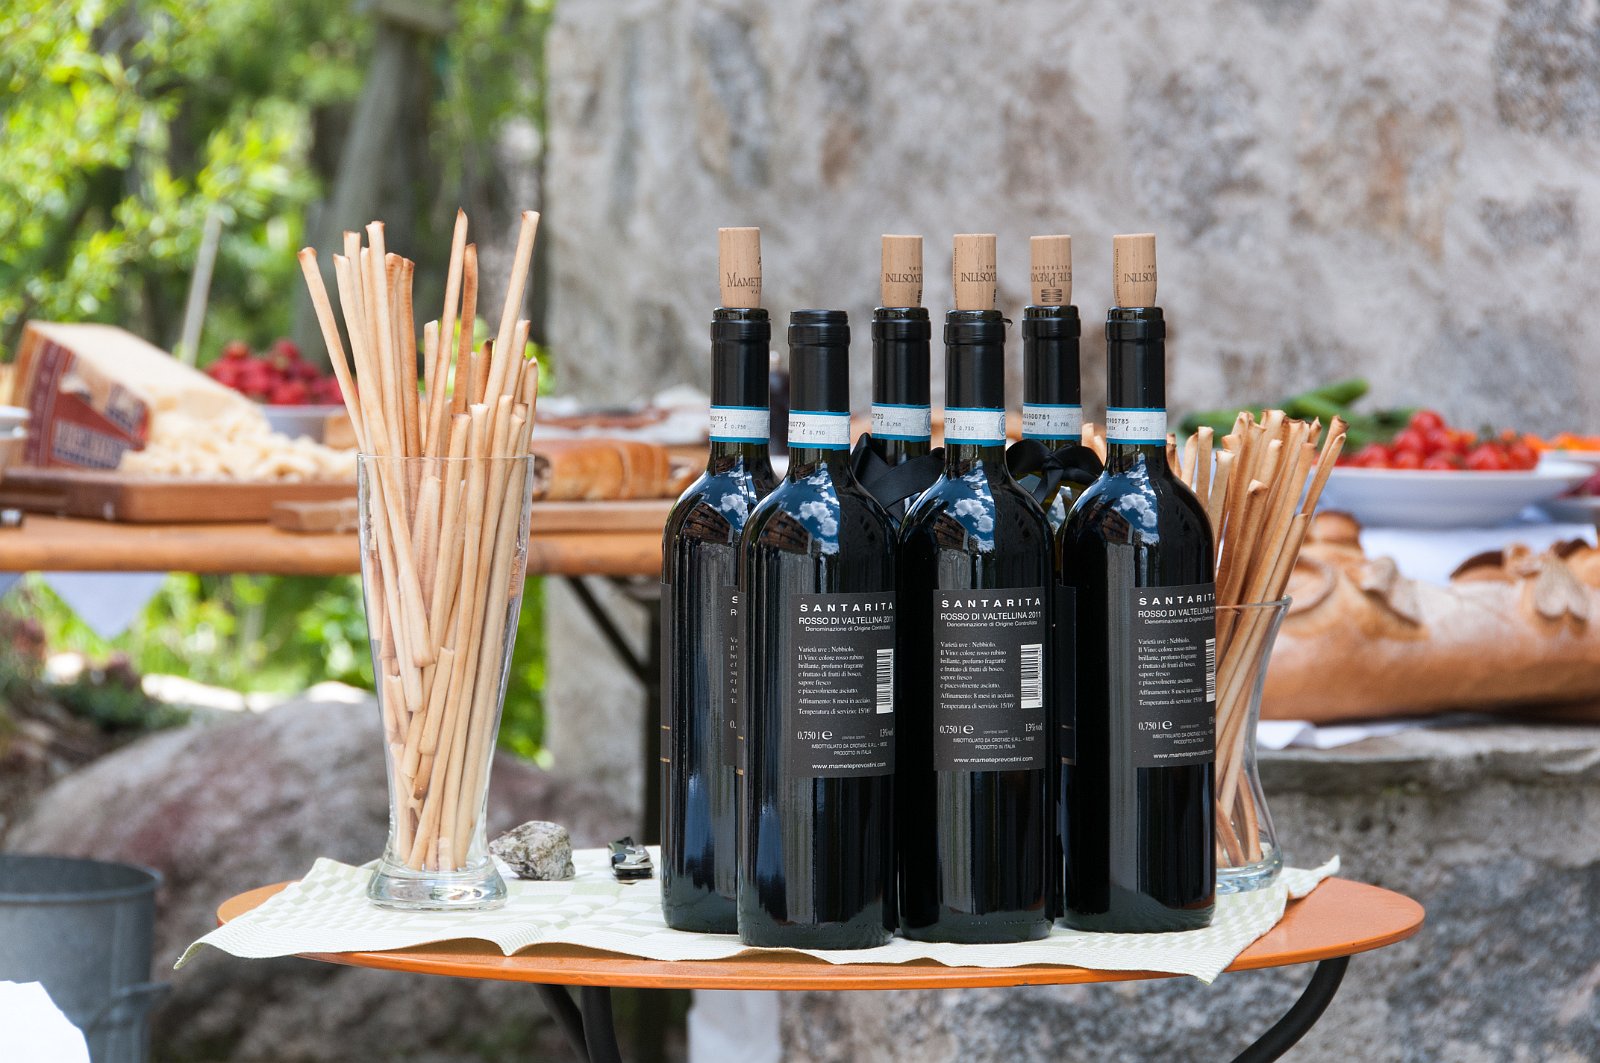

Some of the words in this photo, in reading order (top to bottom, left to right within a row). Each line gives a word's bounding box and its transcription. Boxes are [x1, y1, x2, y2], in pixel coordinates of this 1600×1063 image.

[800, 602, 893, 612] SANTARITA
[941, 598, 1041, 608] SANTARITA
[940, 613, 969, 621] ROSSO
[971, 612, 980, 620] DI
[982, 611, 1027, 620] VALTELLINA
[1028, 611, 1041, 619] 2011
[1138, 610, 1167, 618] ROSSO
[1168, 609, 1177, 617] DI
[798, 617, 829, 625] ROSSO
[831, 617, 840, 625] DI
[841, 616, 882, 625] VALTELLINA
[853, 625, 870, 633] Origine
[940, 702, 970, 710] Temperatura
[953, 756, 1034, 764] www.mameteprevostini.com
